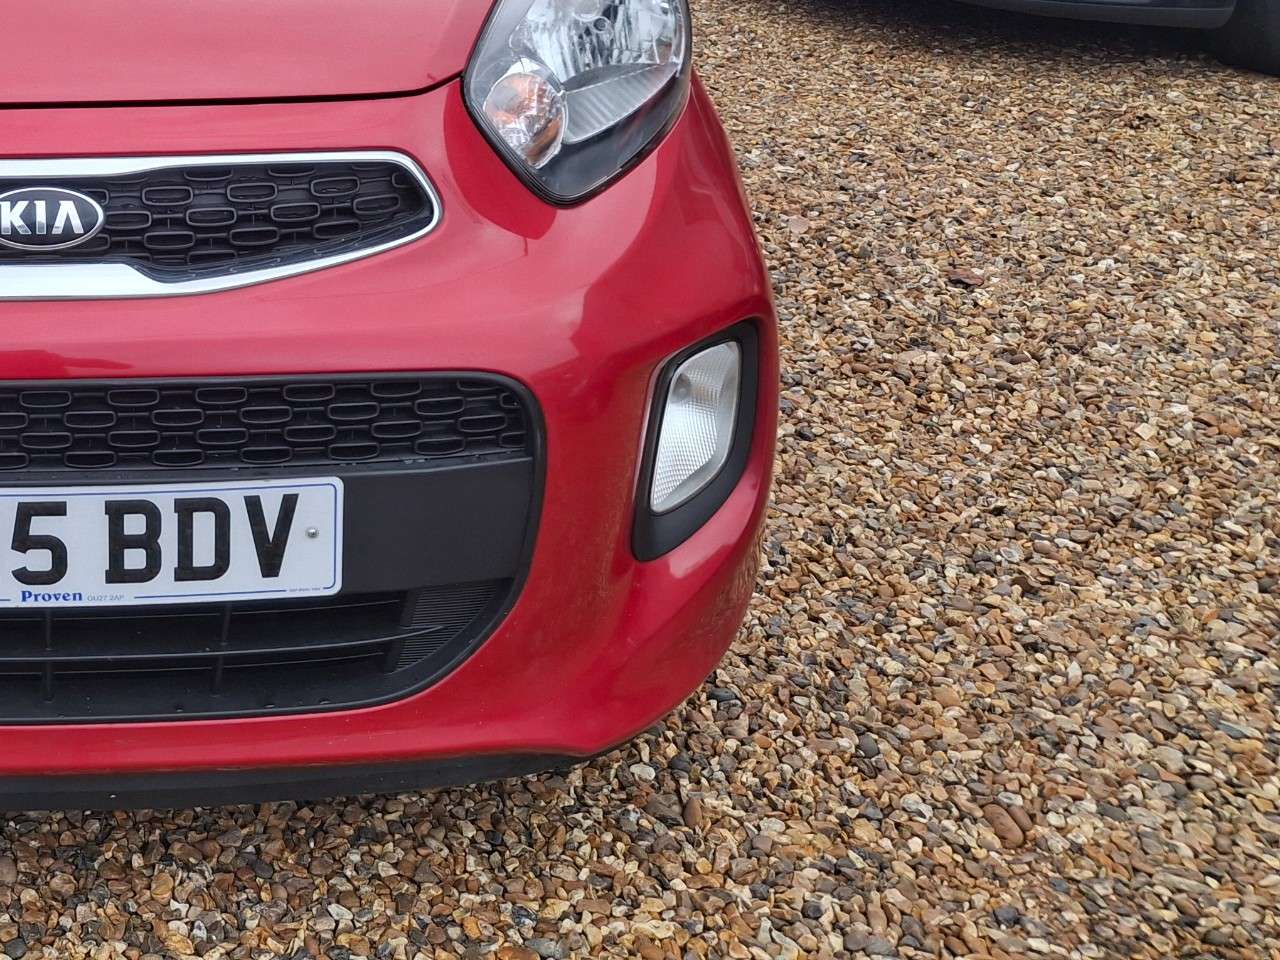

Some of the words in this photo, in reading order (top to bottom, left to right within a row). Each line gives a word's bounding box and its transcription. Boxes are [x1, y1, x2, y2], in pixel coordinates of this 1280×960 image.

[0, 200, 84, 235] KIA
[104, 493, 300, 585] BDV
[21, 590, 83, 602] Proven
